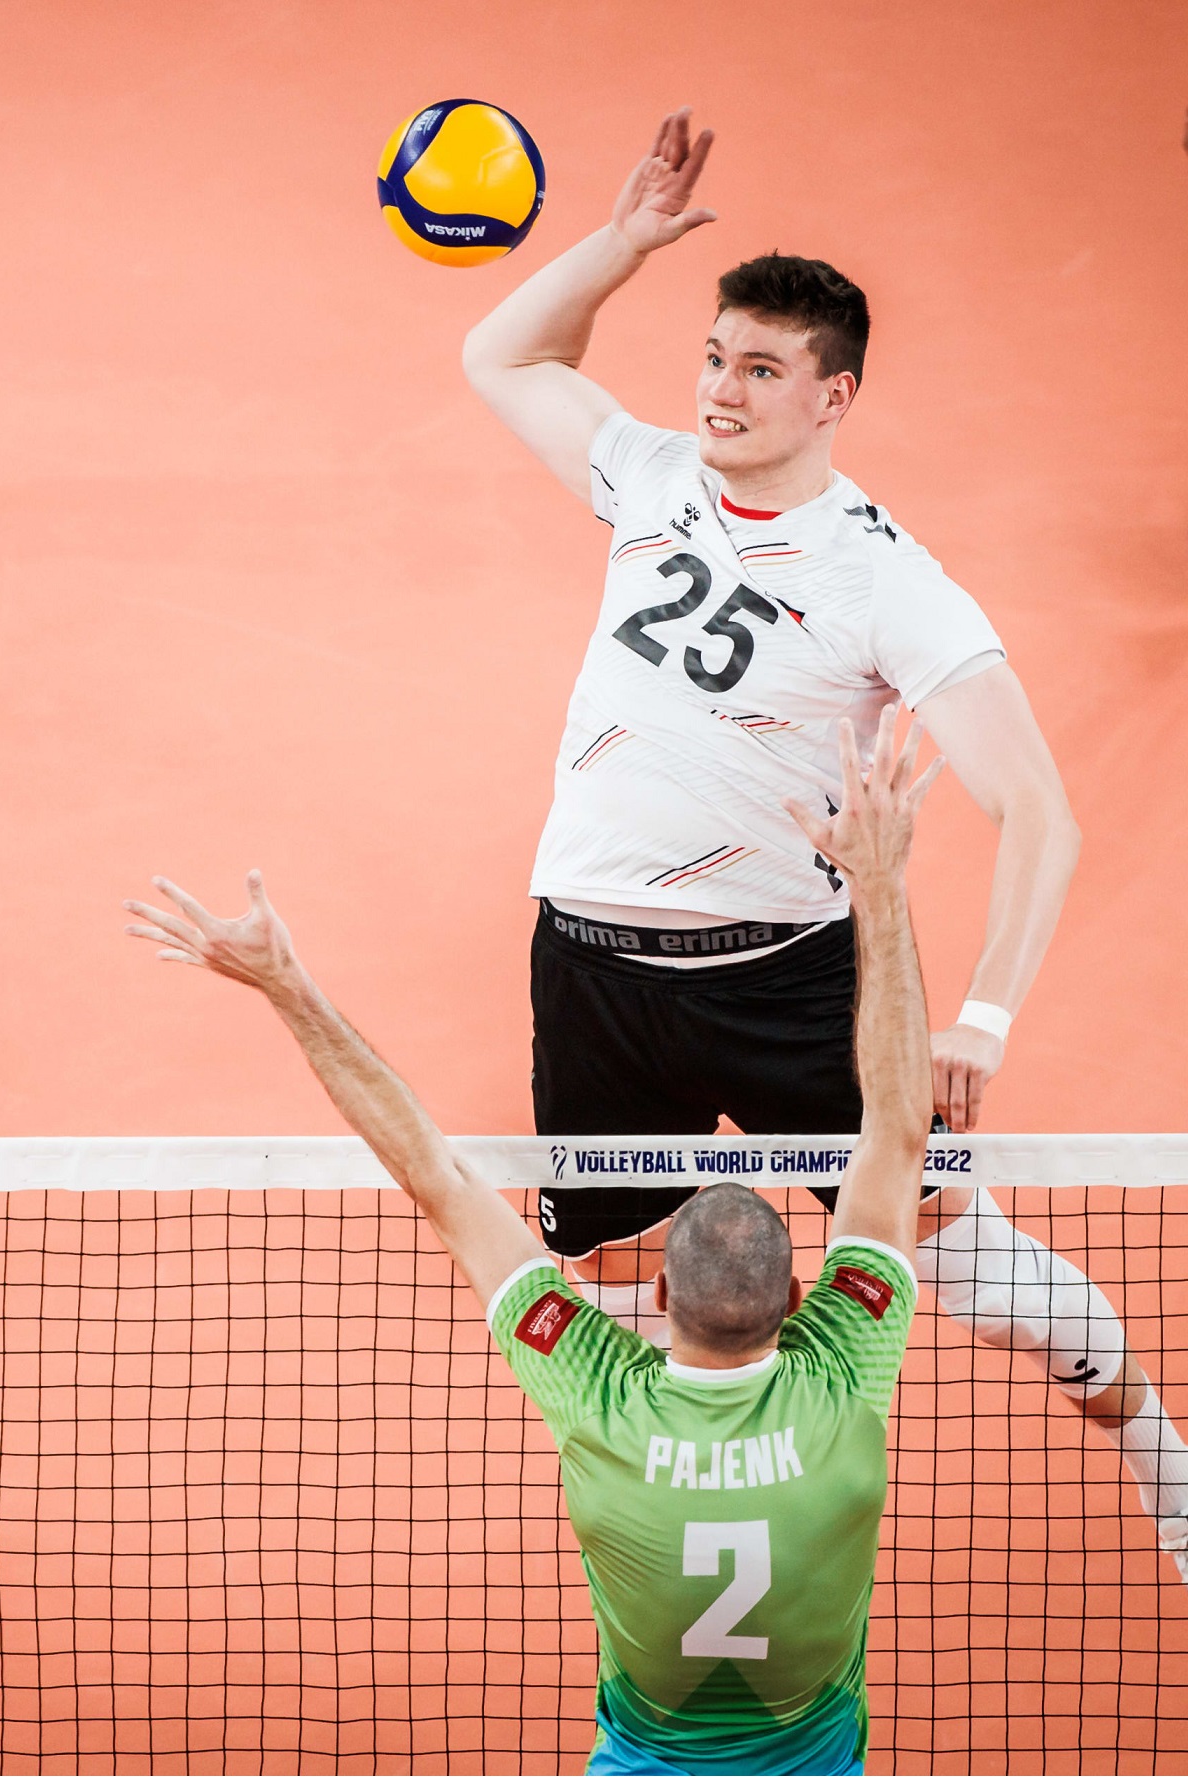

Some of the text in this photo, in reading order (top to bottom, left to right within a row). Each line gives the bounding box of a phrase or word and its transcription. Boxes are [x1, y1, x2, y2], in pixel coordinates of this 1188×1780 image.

[669, 518, 692, 541] hummel
[612, 553, 779, 693] 25
[658, 924, 773, 951] erima
[575, 1150, 686, 1174] VOLLEYBALL
[693, 1150, 763, 1174] WORLD
[541, 1194, 557, 1232] 5
[644, 1426, 803, 1489] PAJENK
[681, 1519, 772, 1660] 2
